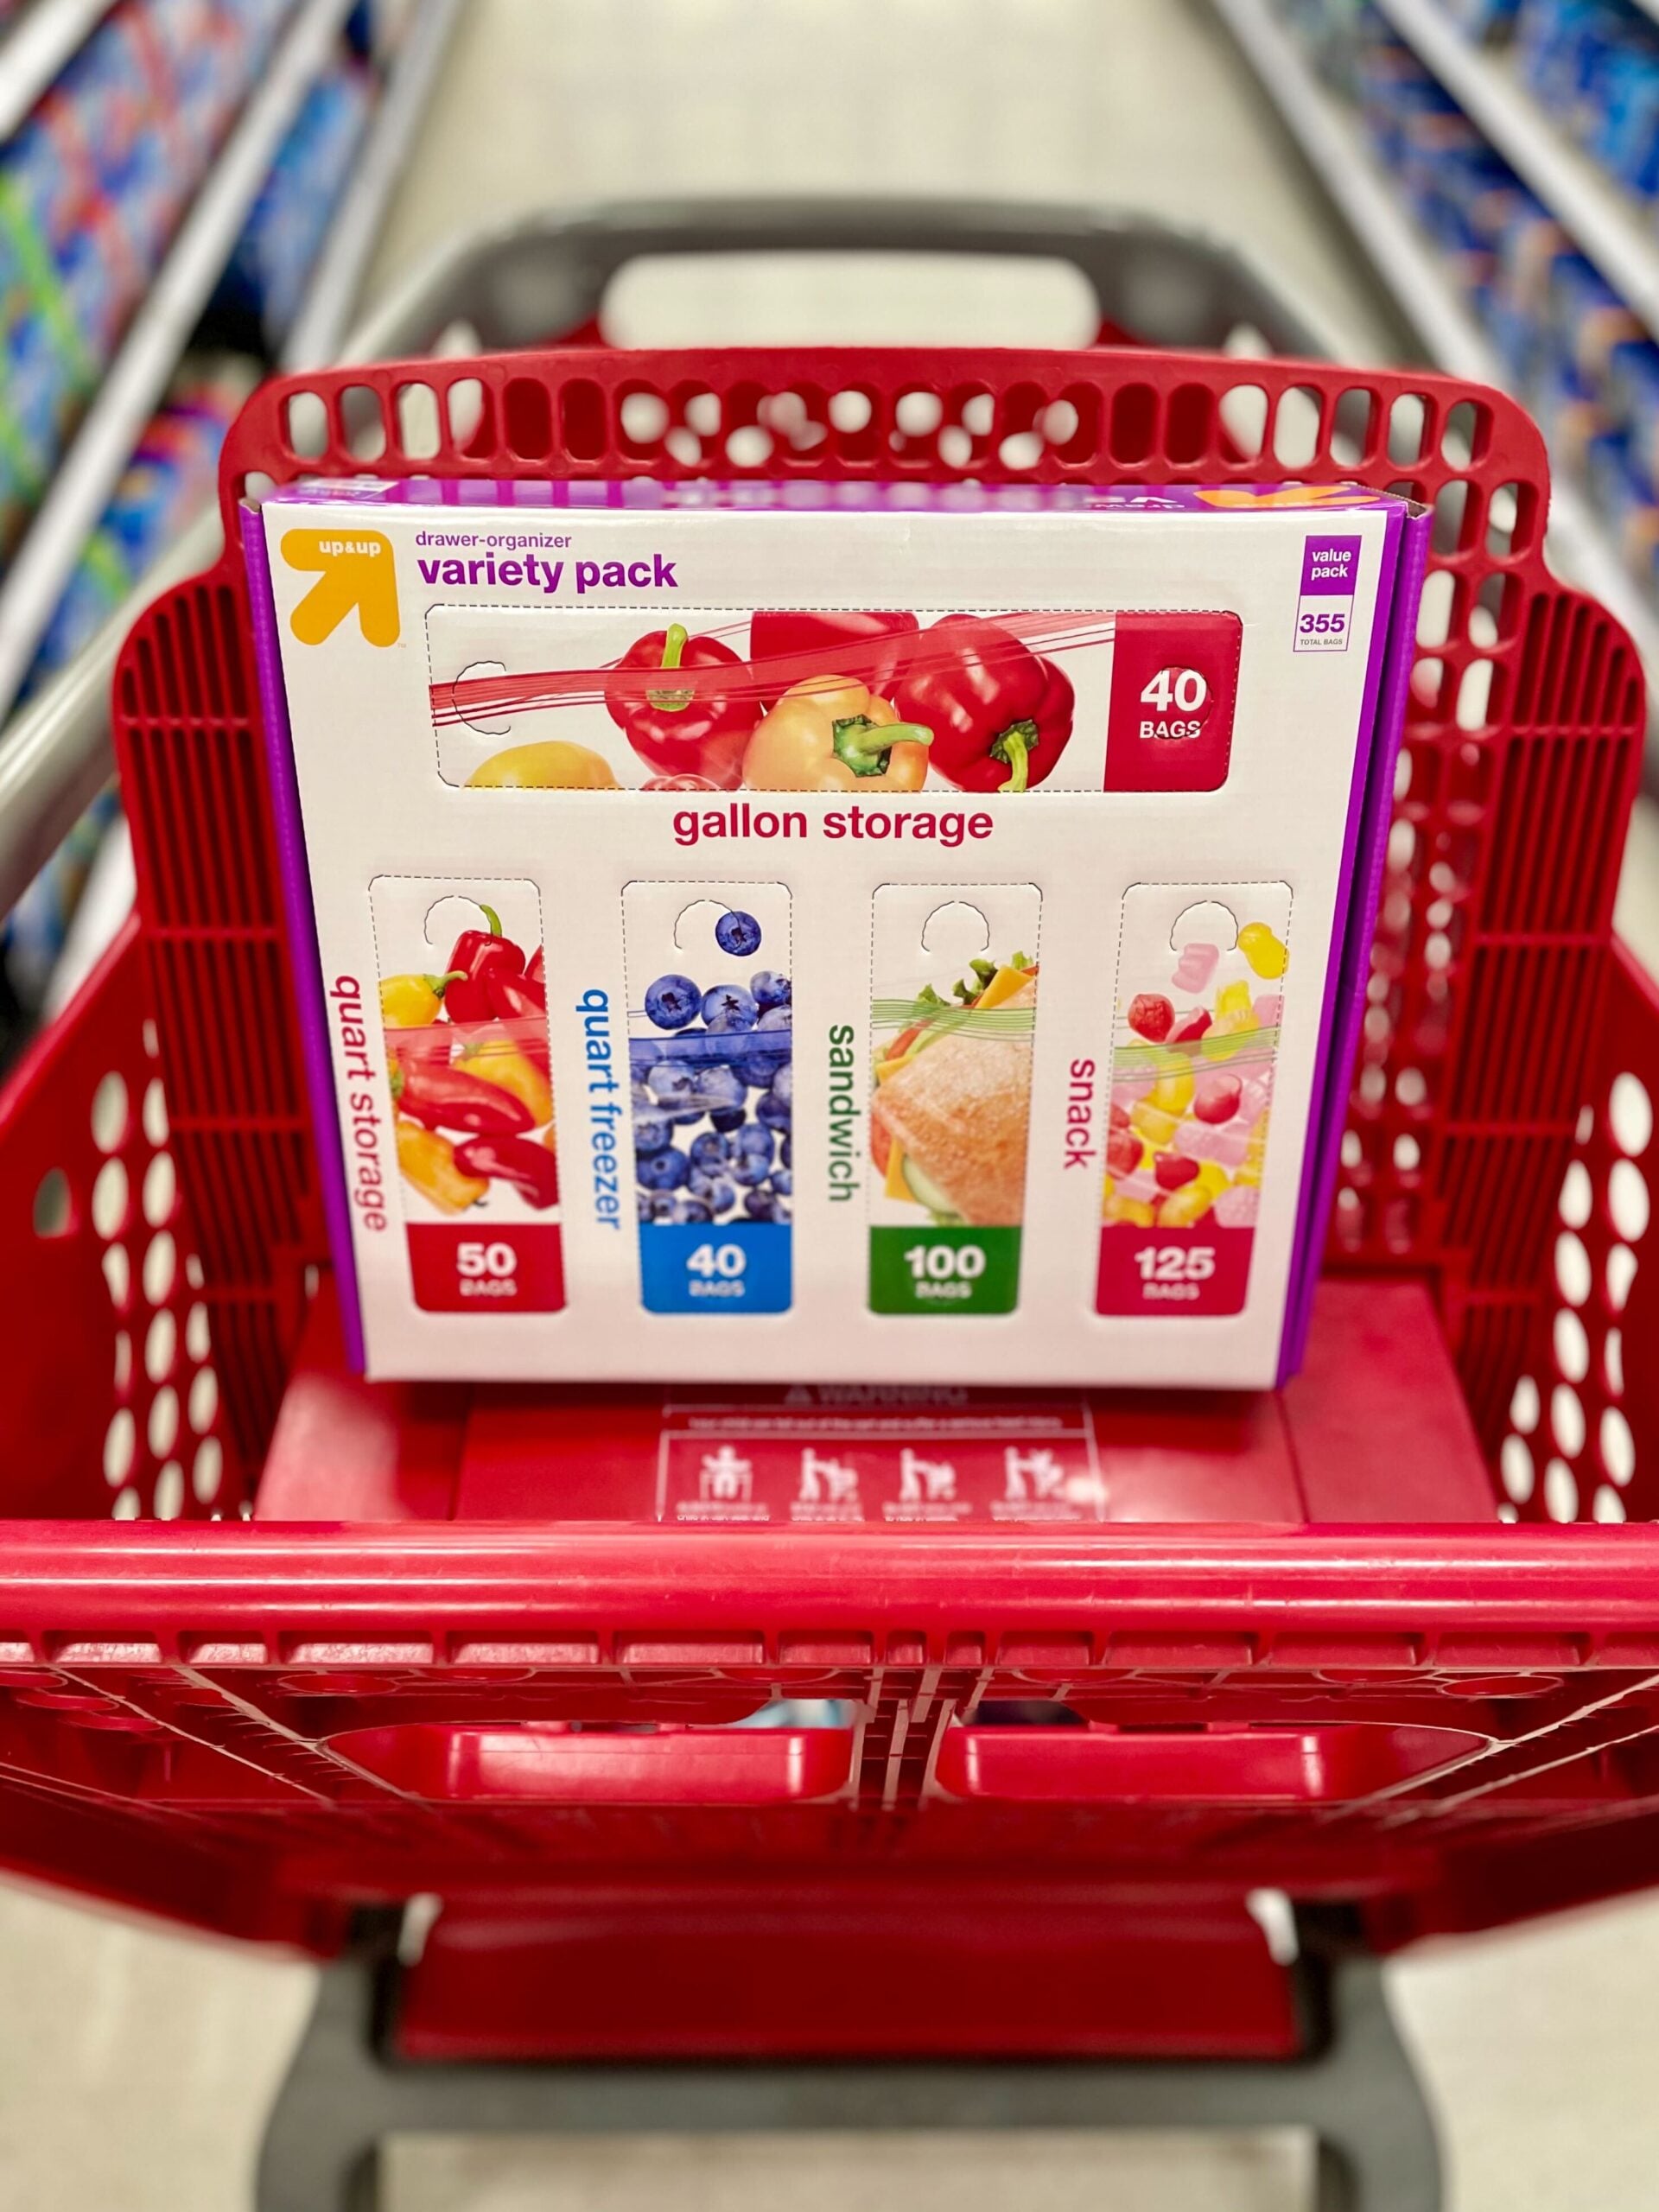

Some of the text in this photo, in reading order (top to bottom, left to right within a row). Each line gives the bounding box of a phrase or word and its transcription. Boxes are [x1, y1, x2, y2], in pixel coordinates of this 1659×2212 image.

[319, 541, 381, 557] up&up
[415, 531, 572, 550] drawer-organizer
[1312, 548, 1351, 563] value
[417, 551, 678, 594] variety pack
[1311, 563, 1348, 581] pack
[1302, 613, 1345, 633] 355
[1140, 669, 1207, 712] 40
[1139, 720, 1201, 740] BAGS
[673, 803, 994, 848] gallon storage
[329, 975, 387, 1232] quart storage
[575, 988, 623, 1230] quart freezer
[829, 1025, 861, 1201] sandwich
[1065, 1059, 1096, 1168] snack
[457, 1243, 517, 1276] 50
[686, 1244, 747, 1277] 40
[905, 1245, 986, 1279] 100
[1135, 1247, 1215, 1281] 125
[460, 1279, 517, 1296] BAGS
[689, 1280, 745, 1297] BAGS
[915, 1281, 972, 1299] BAGS
[1143, 1282, 1199, 1300] BAGS
